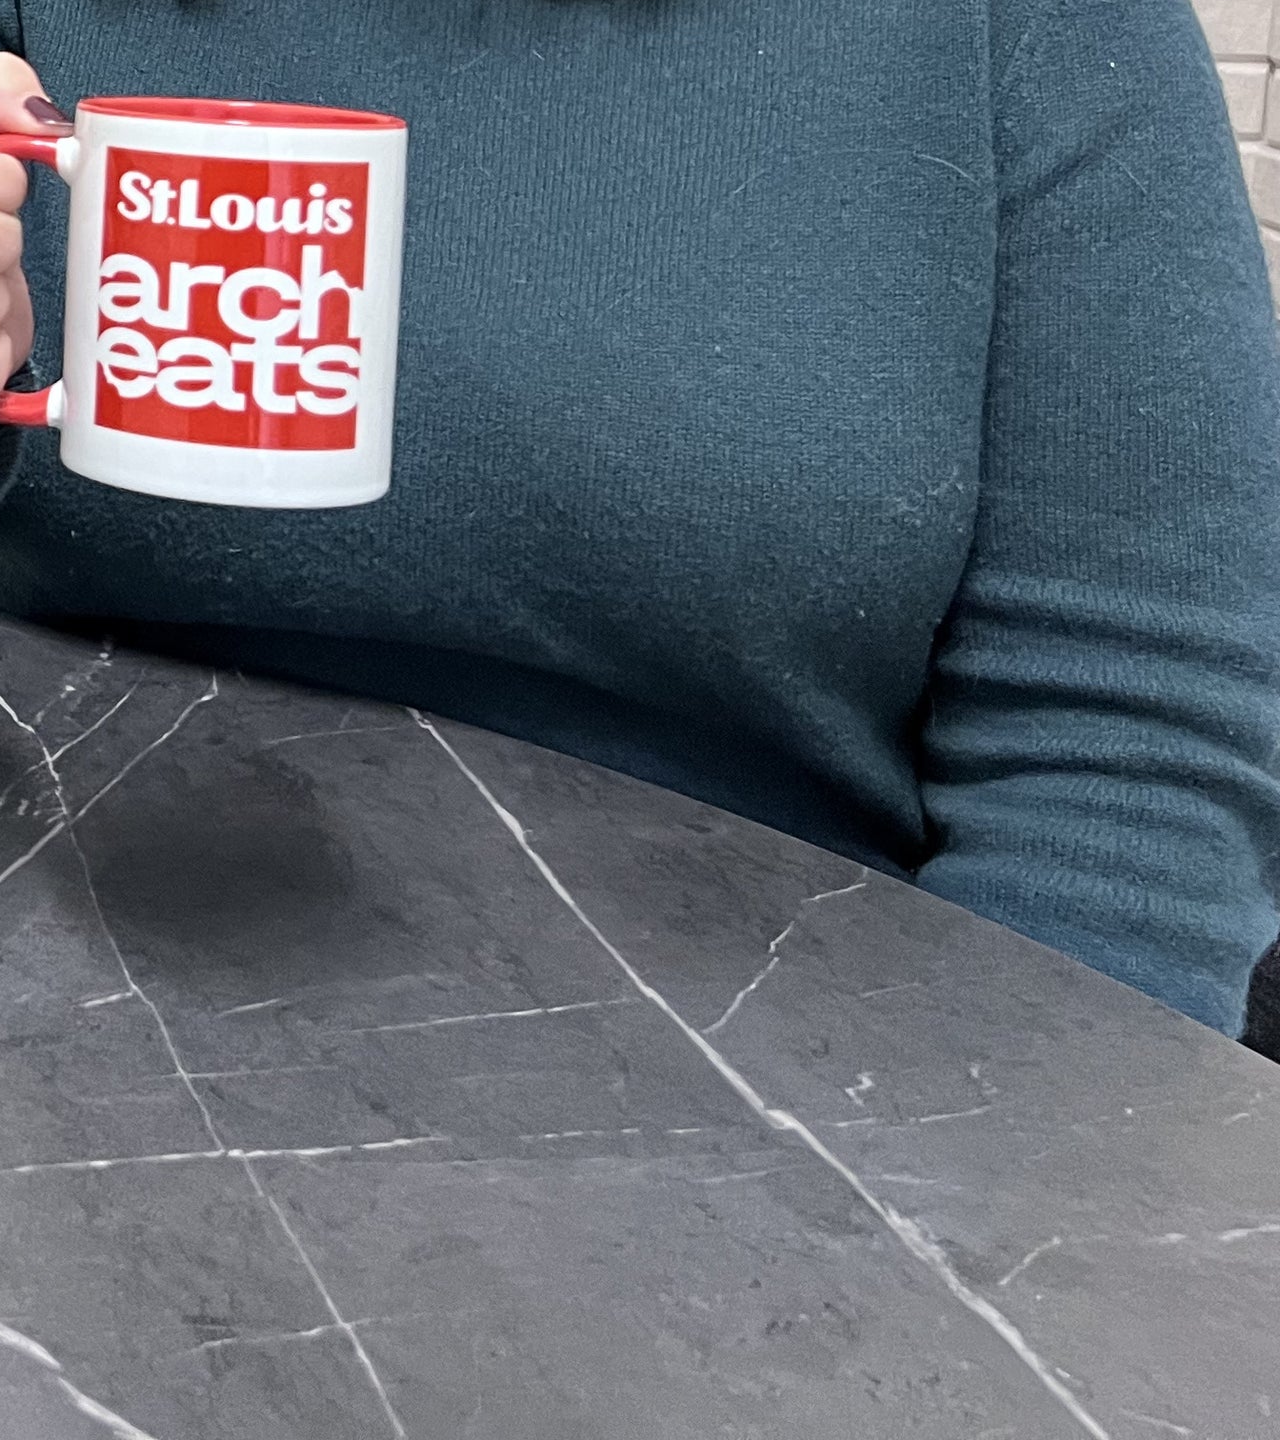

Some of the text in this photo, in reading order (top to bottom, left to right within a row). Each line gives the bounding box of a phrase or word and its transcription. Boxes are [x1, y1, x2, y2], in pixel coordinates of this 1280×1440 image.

[117, 170, 353, 235] St.Louis
[98, 245, 364, 339] arch
[96, 326, 361, 416] eats
